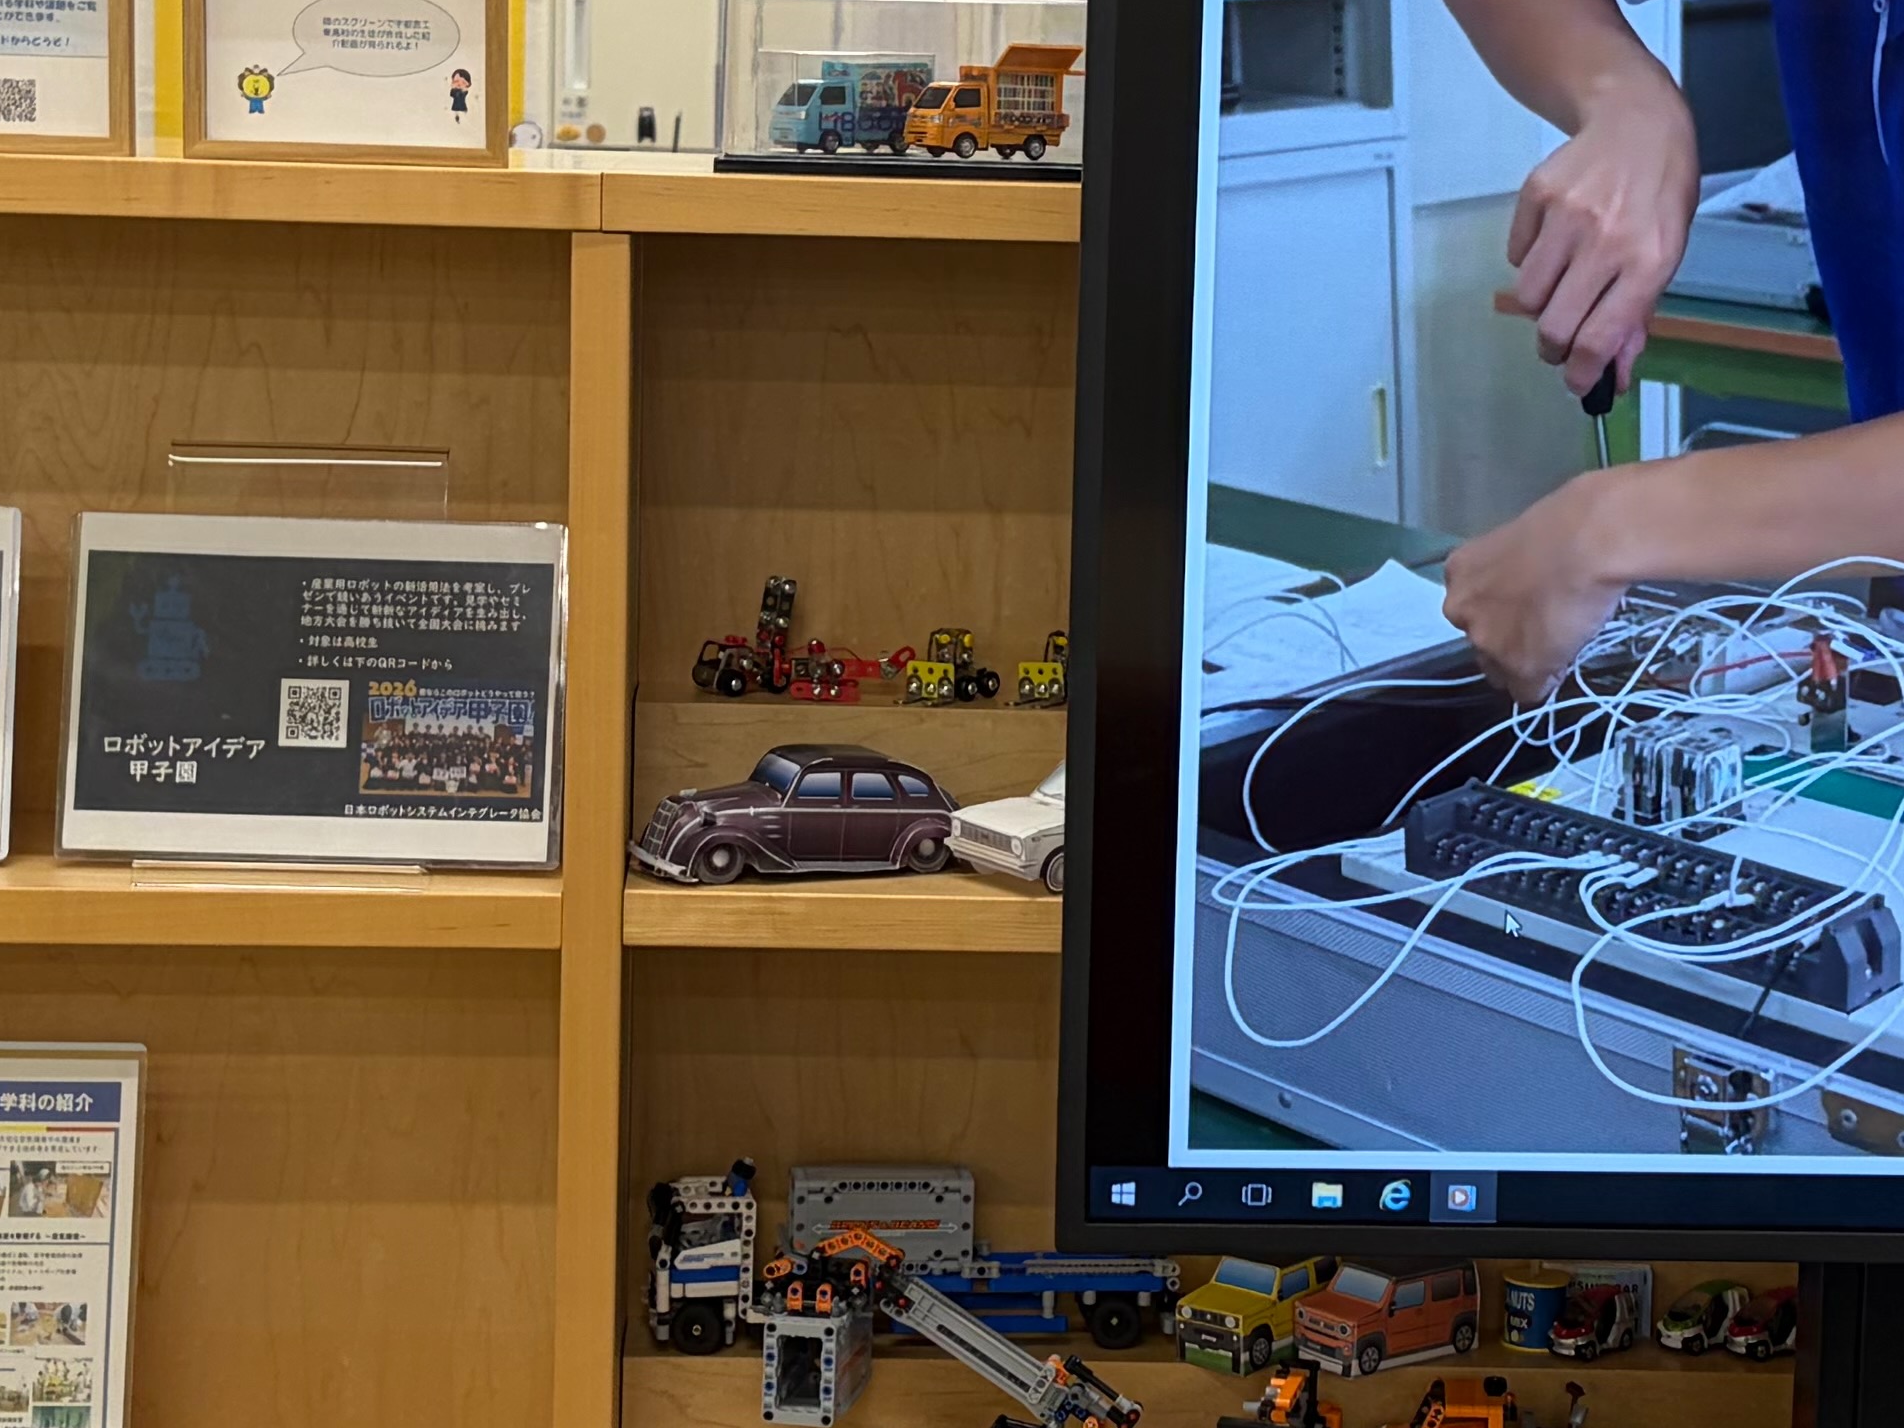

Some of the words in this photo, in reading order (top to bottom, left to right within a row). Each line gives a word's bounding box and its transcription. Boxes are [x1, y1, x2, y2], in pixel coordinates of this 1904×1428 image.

[367, 678, 417, 697] 2026
[103, 735, 266, 761] ロボットアイデア
[129, 760, 198, 784] 甲子園
[0, 1091, 94, 1113] 学科の紹介
